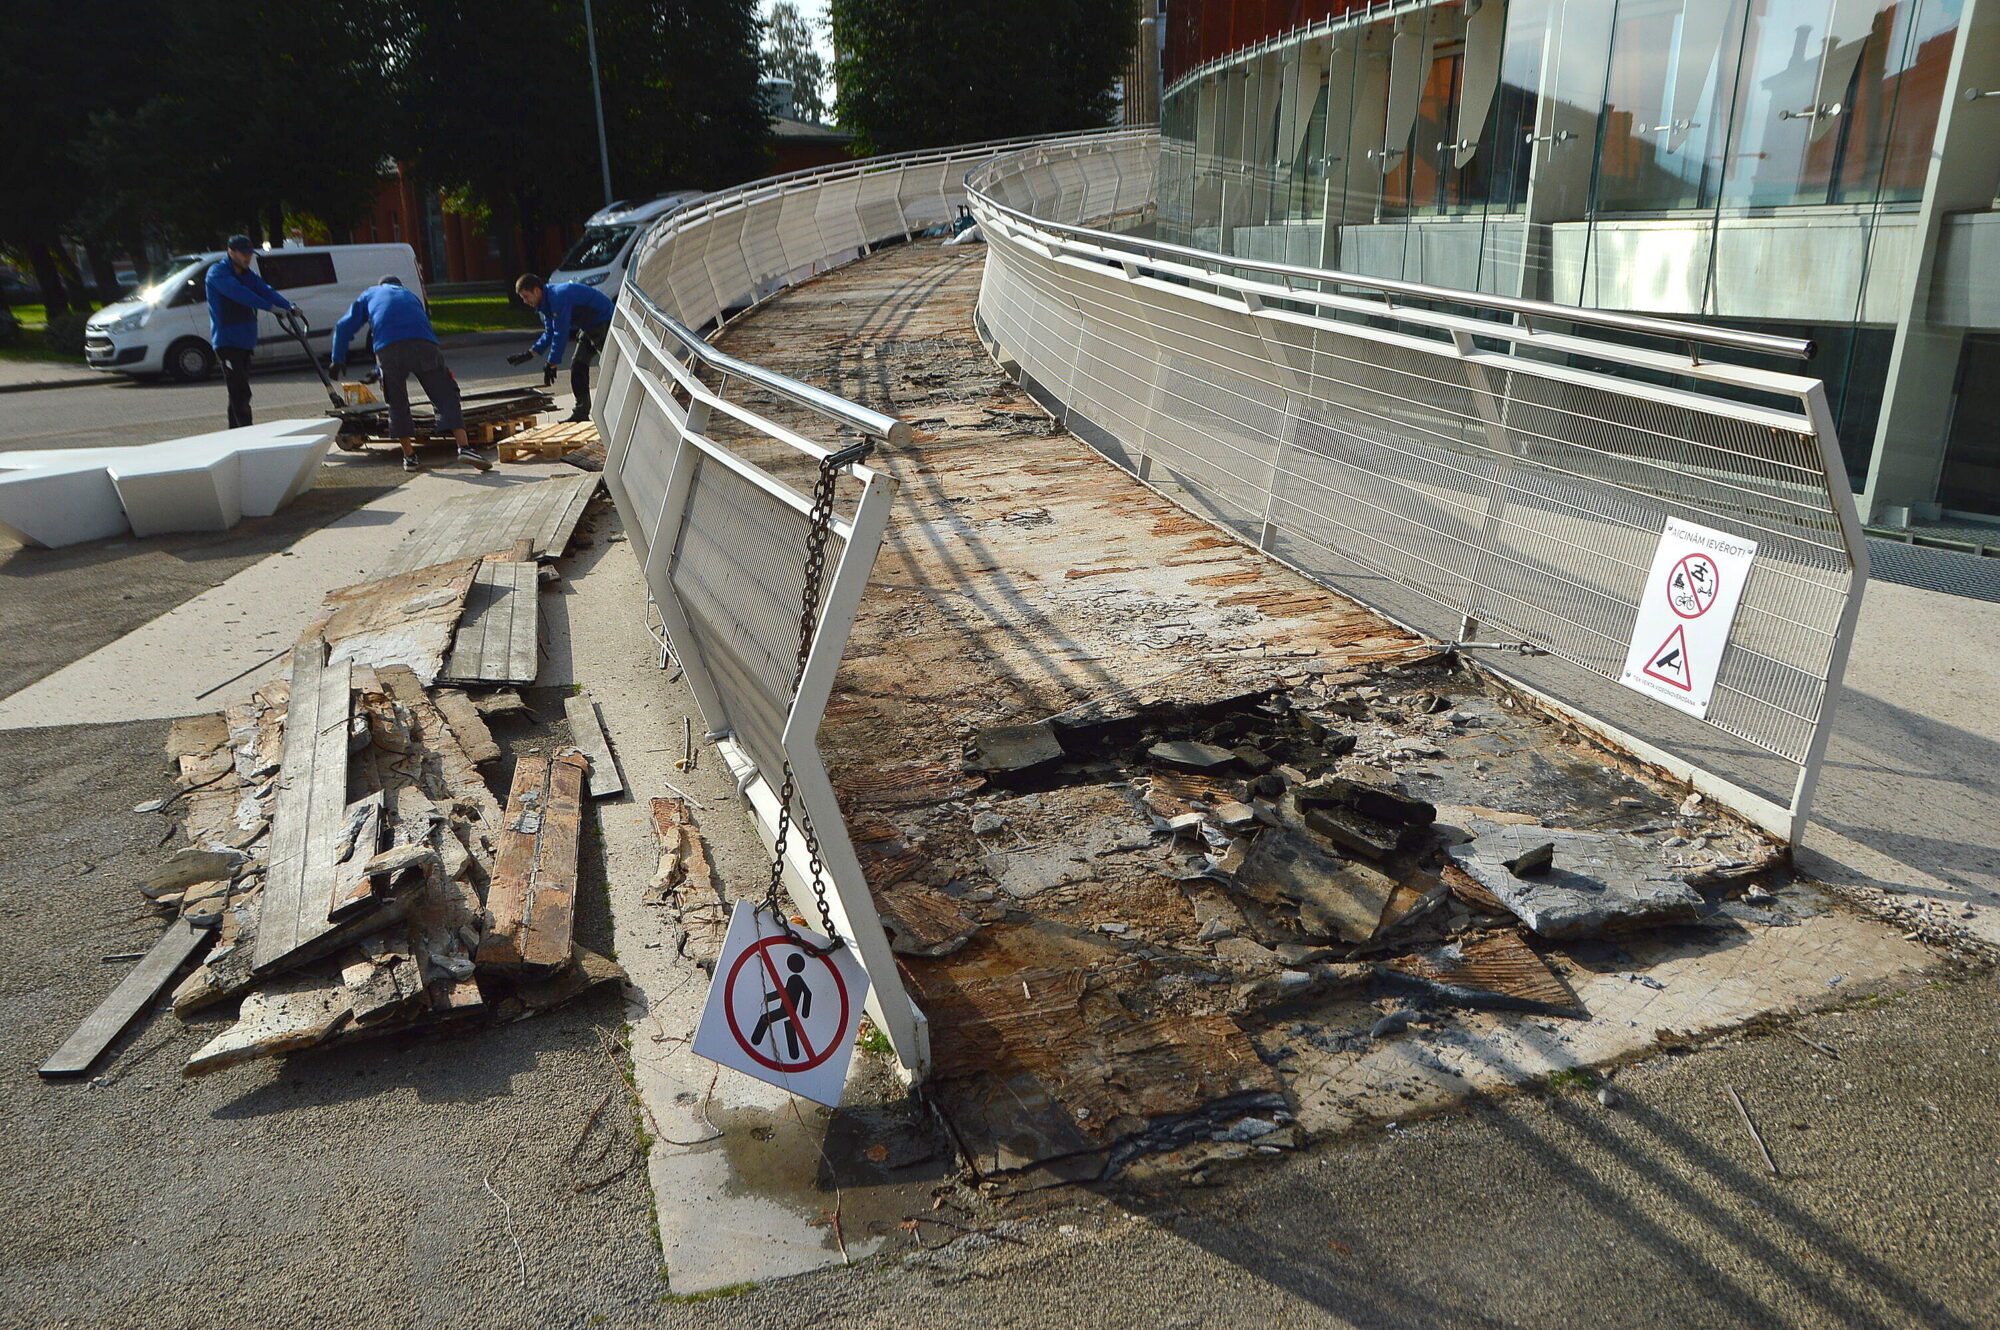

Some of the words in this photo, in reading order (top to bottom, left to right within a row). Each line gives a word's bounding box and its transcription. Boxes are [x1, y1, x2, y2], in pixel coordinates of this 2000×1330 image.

[1671, 528, 1705, 546] AICINĀM
[1706, 538, 1746, 557] IEVĒROT!
[1655, 685, 1696, 706] VIDEONOVĒROŠANA
